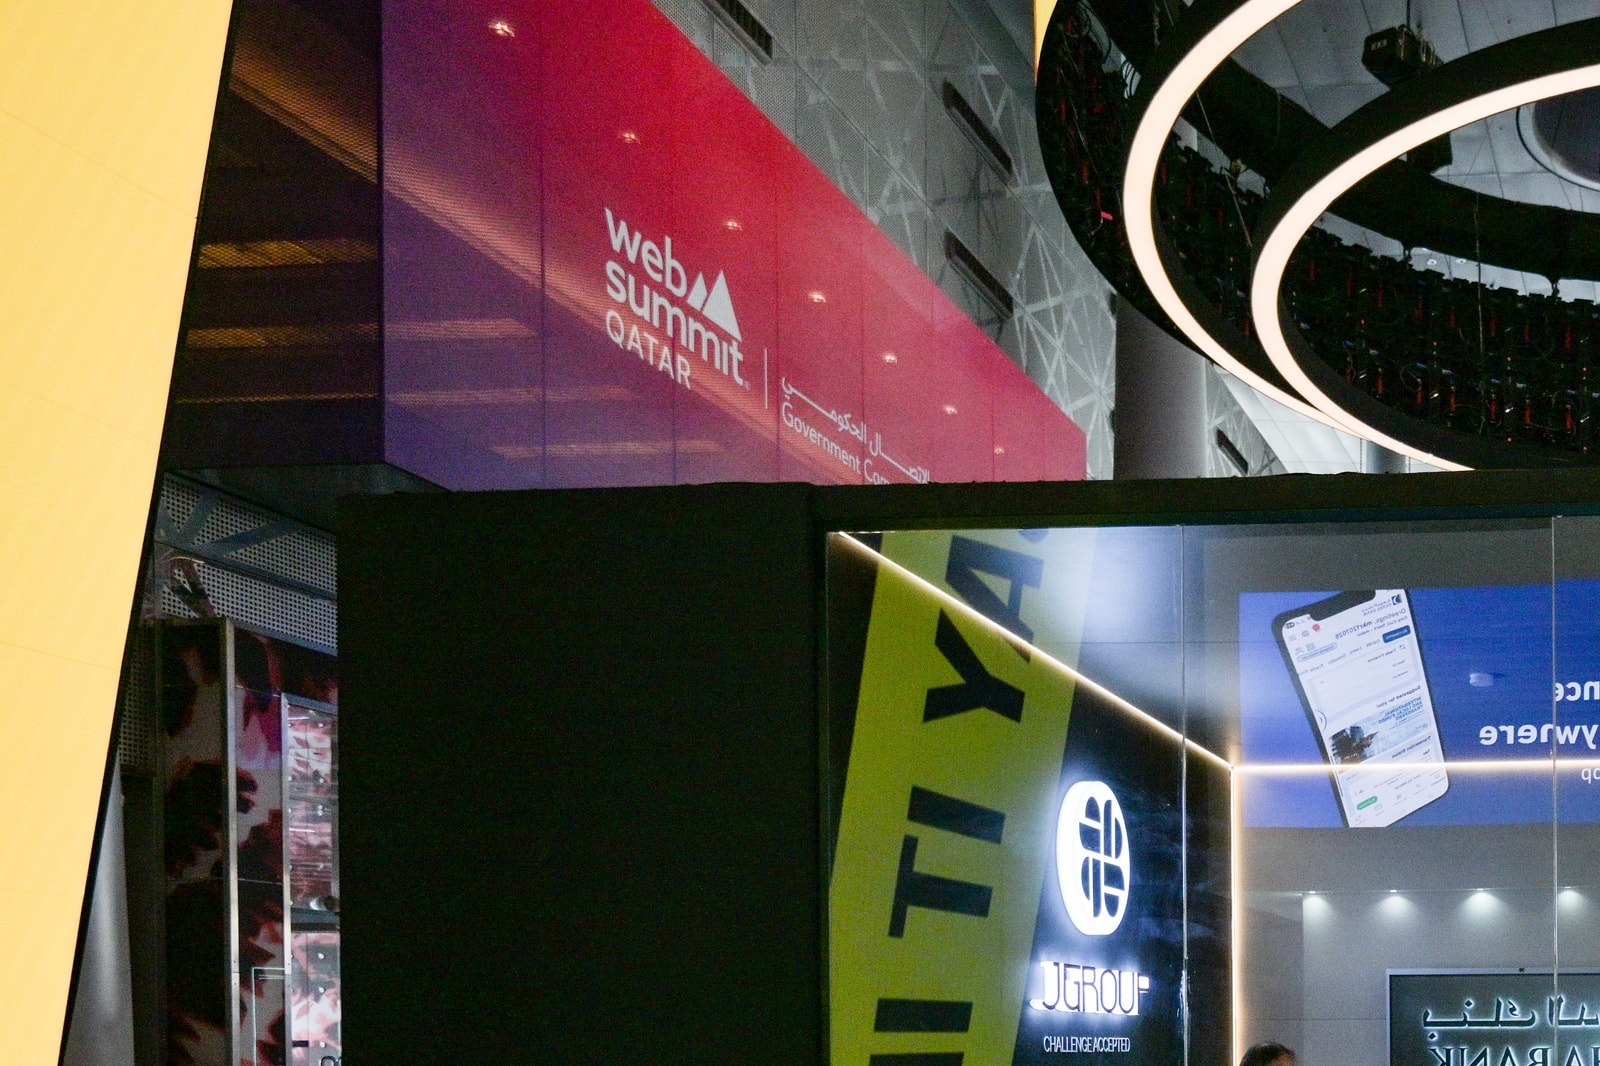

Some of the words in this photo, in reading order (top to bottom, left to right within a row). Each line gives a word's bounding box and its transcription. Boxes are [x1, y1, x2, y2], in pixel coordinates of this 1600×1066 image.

[604, 207, 688, 299] web
[604, 260, 744, 389] summit
[605, 309, 693, 391] QATAR
[781, 401, 862, 475] Government
[1043, 1035, 1092, 1053] CHALLENGE
[1093, 1036, 1131, 1053] ACCEPTED
